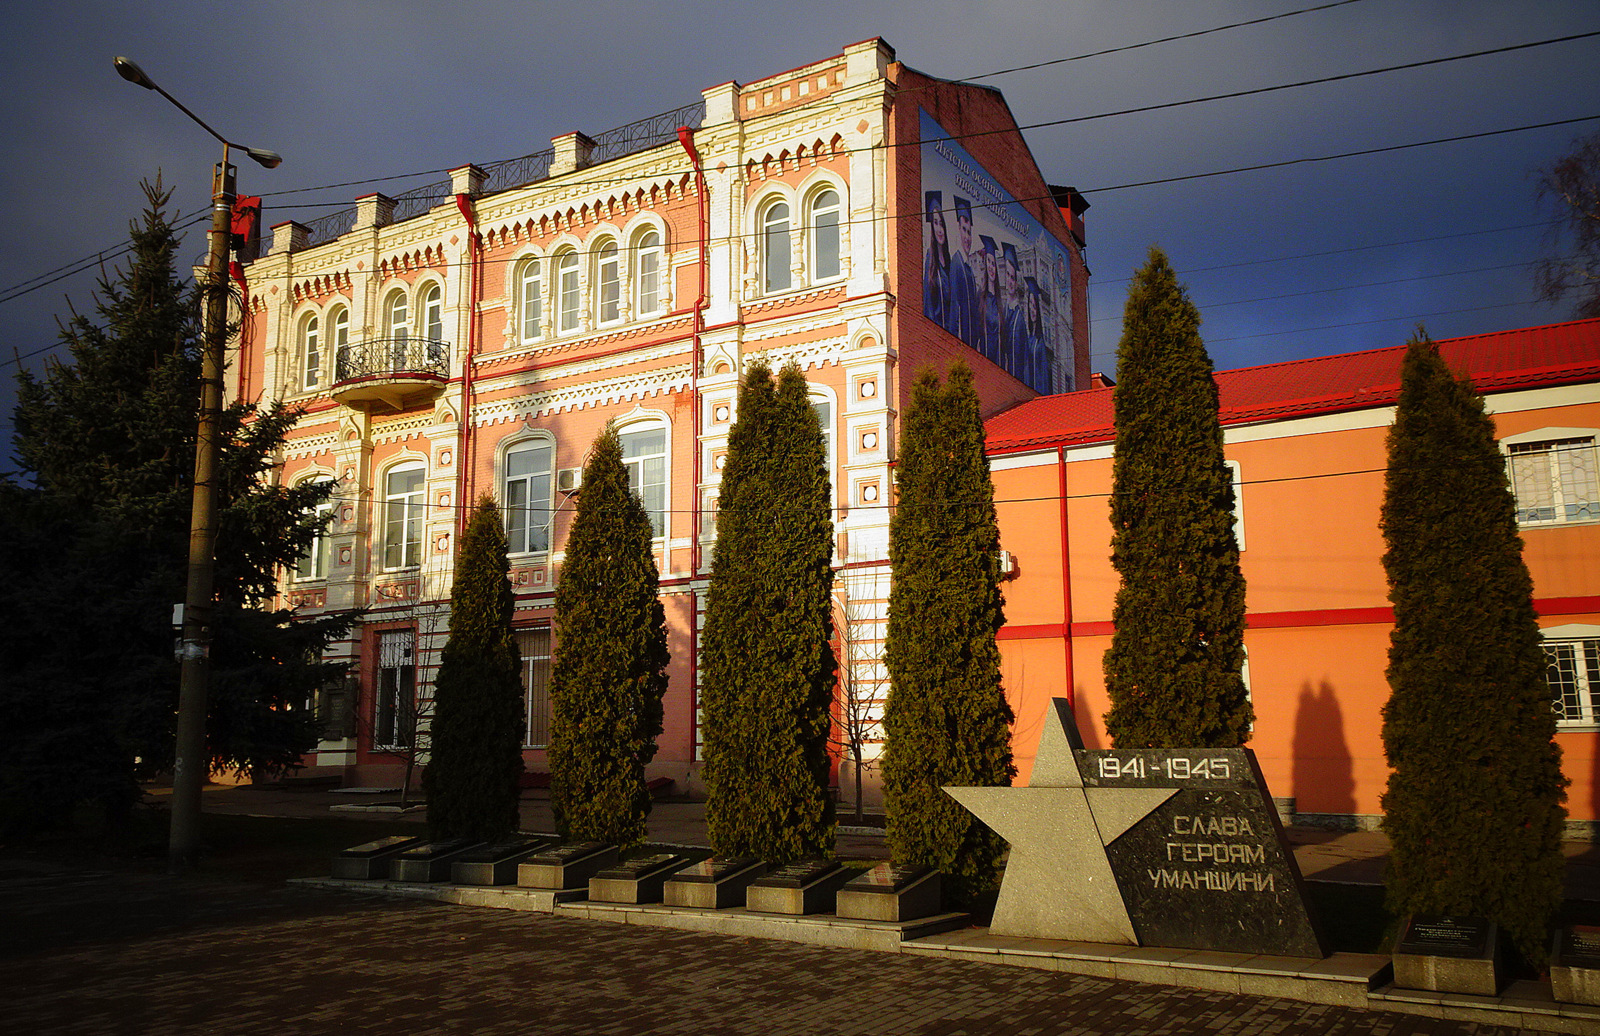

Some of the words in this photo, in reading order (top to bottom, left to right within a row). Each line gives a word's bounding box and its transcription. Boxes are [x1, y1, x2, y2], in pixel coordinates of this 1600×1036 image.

[935, 138, 970, 174] Якісна
[971, 169, 1004, 201] освіта
[1173, 815, 1254, 836] СЛАВА
[1166, 843, 1265, 864] ГЕРОЯМ
[1147, 869, 1275, 892] УМАНЩИНИ
